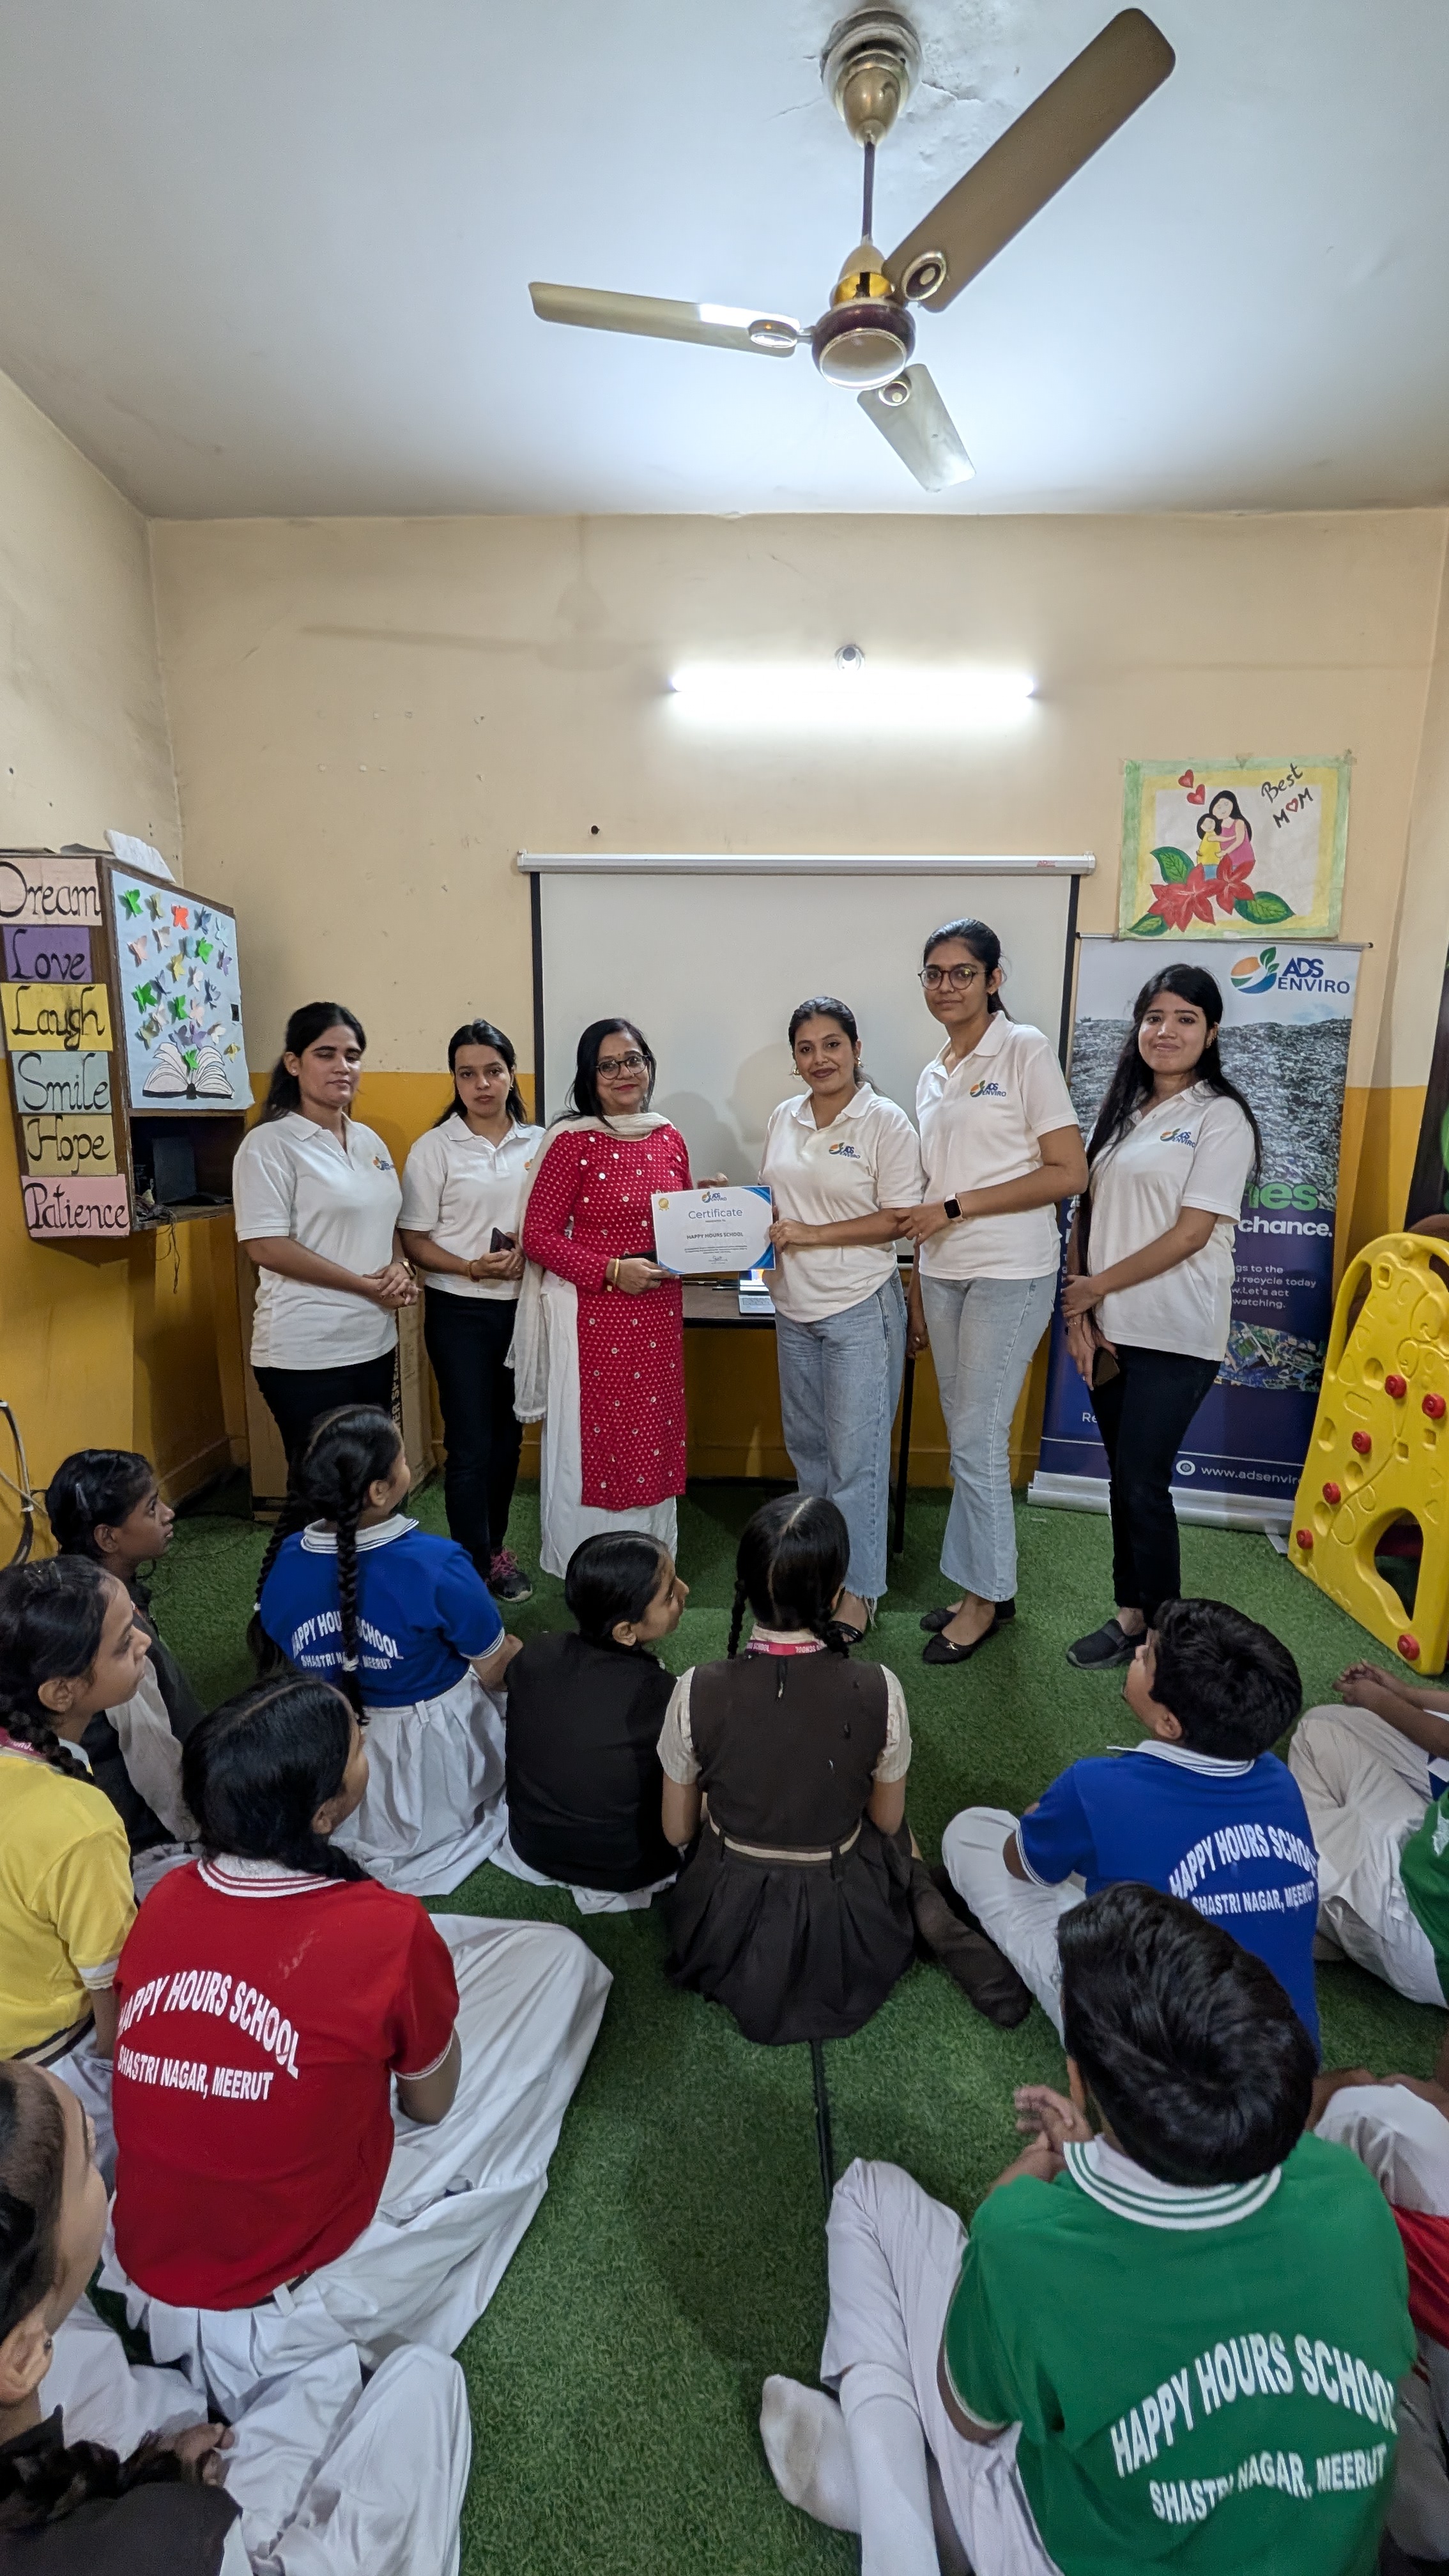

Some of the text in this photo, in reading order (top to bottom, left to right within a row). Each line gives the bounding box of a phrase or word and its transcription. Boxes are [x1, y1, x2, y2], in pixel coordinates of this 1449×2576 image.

[1261, 763, 1303, 803] Best
[0, 861, 102, 918] Dream
[12, 928, 86, 980] Love
[1282, 958, 1324, 978] ADS
[1278, 977, 1350, 994] ENVIRO
[12, 985, 105, 1051] Laugh
[18, 1052, 109, 1110] Smile
[27, 1115, 111, 1175] Hope
[843, 1146, 855, 1154] ADS
[24, 1183, 130, 1230] Patience
[688, 1209, 743, 1219] Certificate
[1238, 1216, 1333, 1238] chance.
[1243, 1276, 1283, 1286] recycle
[1285, 1278, 1317, 1289] today
[1266, 1265, 1284, 1274] the
[1232, 1298, 1285, 1309] watching.
[1271, 1289, 1289, 1298] act
[317, 1611, 342, 1637] HOU
[300, 1651, 335, 1668] SHASTRI
[1169, 1836, 1216, 1899] HAPPY
[1214, 1823, 1270, 1865] HOURS
[1191, 1892, 1241, 1916] SHASTRI
[1242, 1889, 1285, 1913] NAGAR,
[163, 1970, 232, 2016] HOURS
[229, 1981, 299, 2080] SCHOOL
[118, 2044, 274, 2101] SHASTRI NAGAR, MEERUT
[1110, 2368, 1194, 2478] HAPPY
[1195, 2332, 1294, 2416] HOURS
[1316, 2443, 1387, 2492] MEERUT
